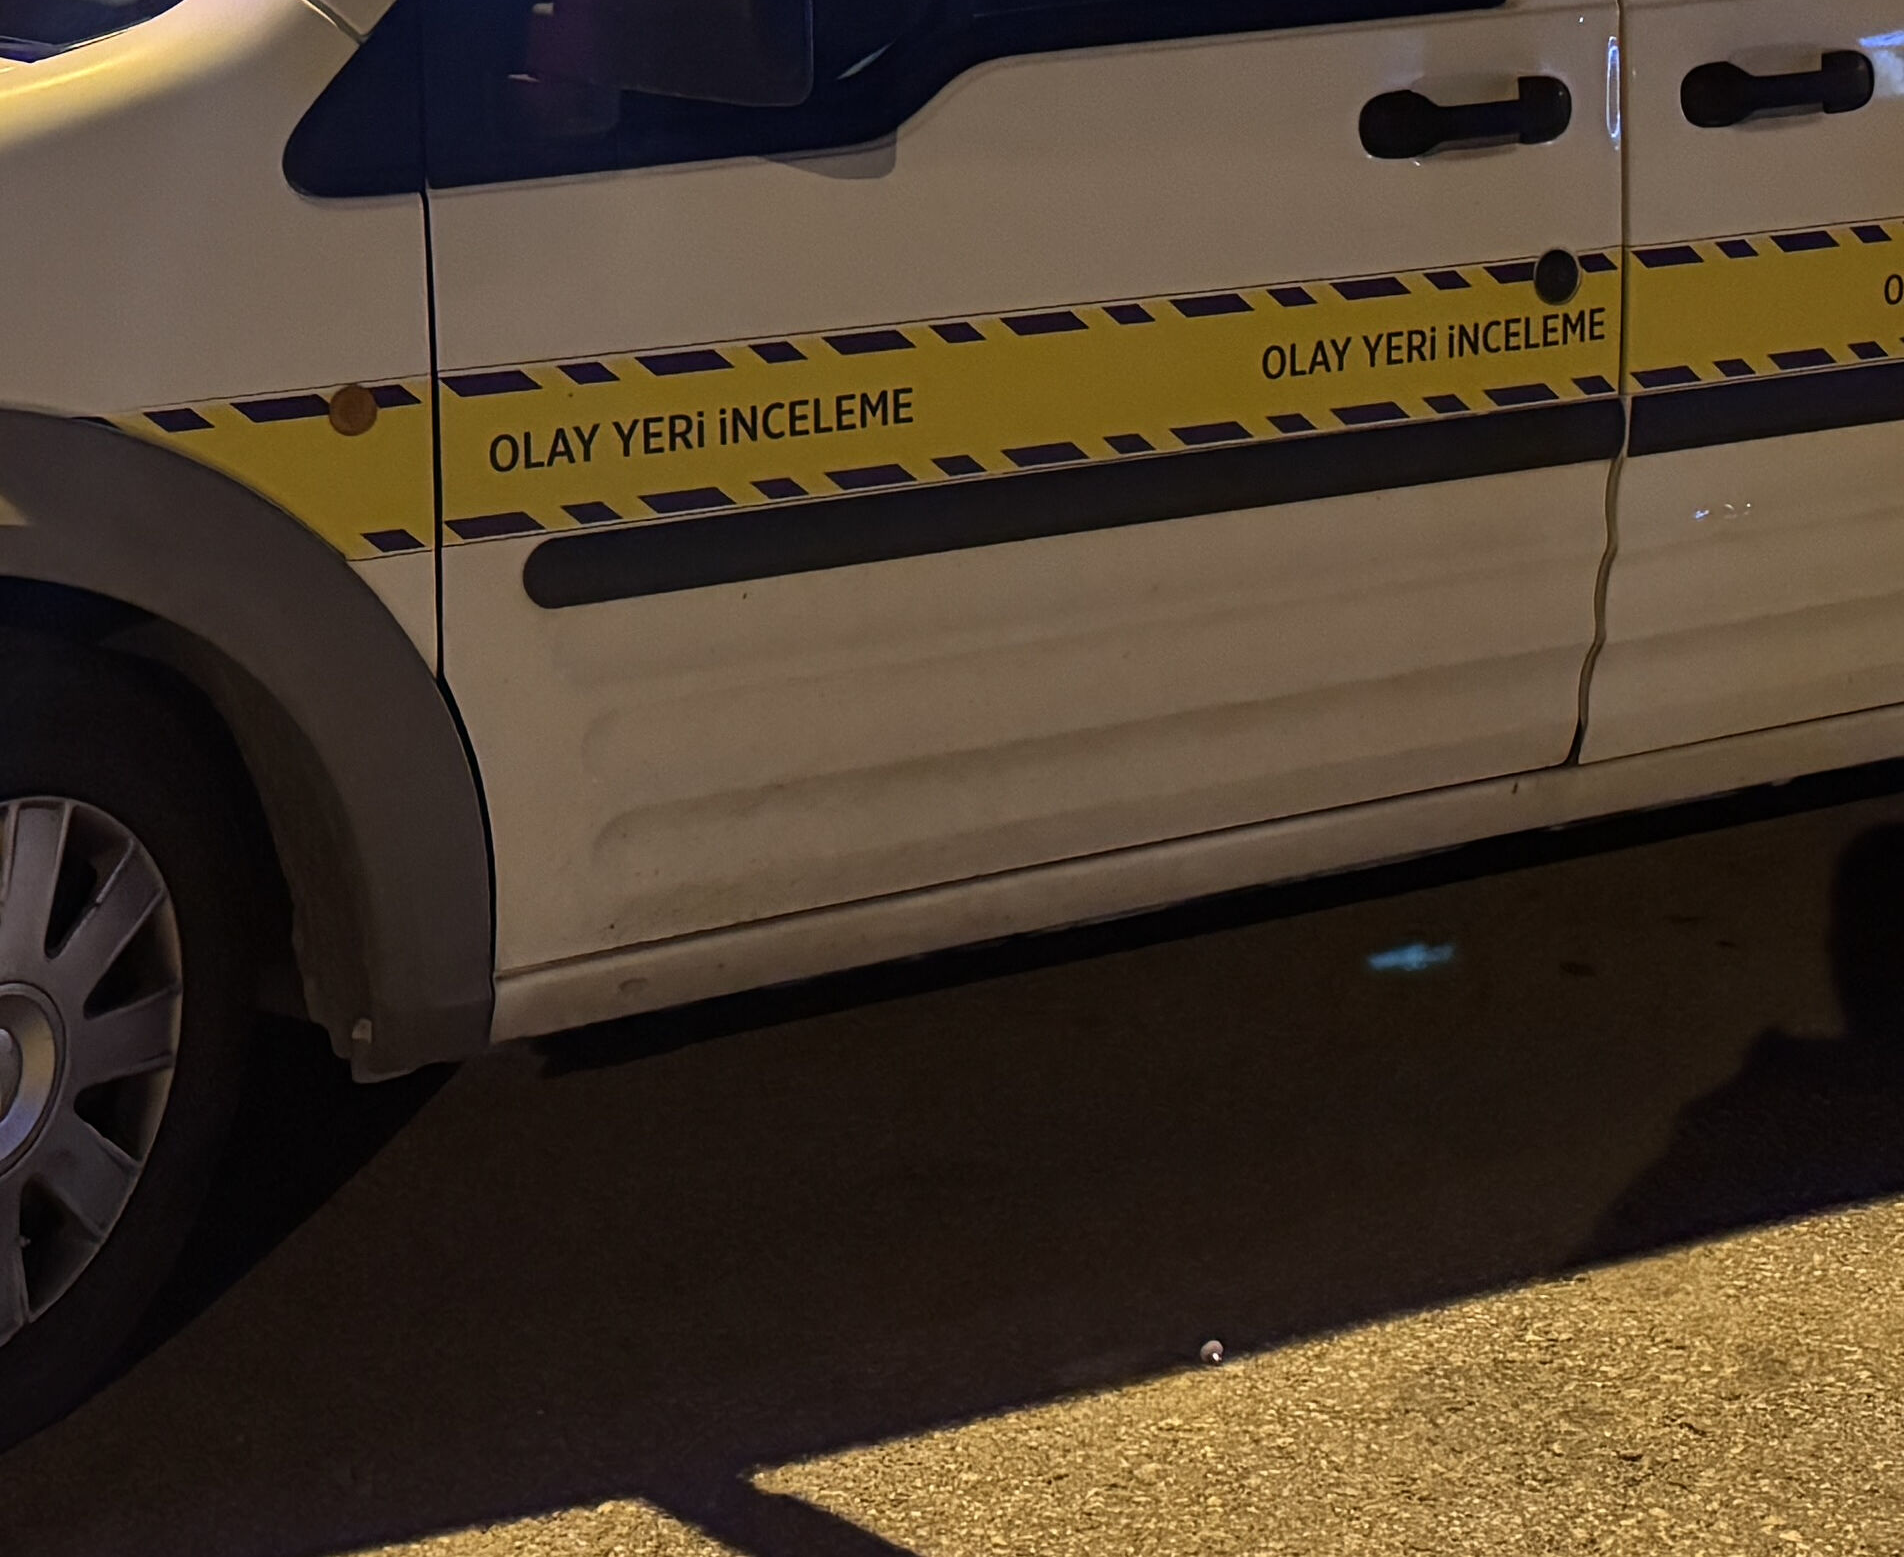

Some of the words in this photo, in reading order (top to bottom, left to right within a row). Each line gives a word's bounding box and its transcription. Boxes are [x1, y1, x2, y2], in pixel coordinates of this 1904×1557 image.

[1261, 336, 1352, 380] OLAY
[1361, 326, 1437, 369] YERİ
[1447, 306, 1607, 359] İNCELEME
[488, 422, 601, 473] OLAY
[611, 410, 705, 457] YERİ
[717, 386, 914, 446] İNCELEME
